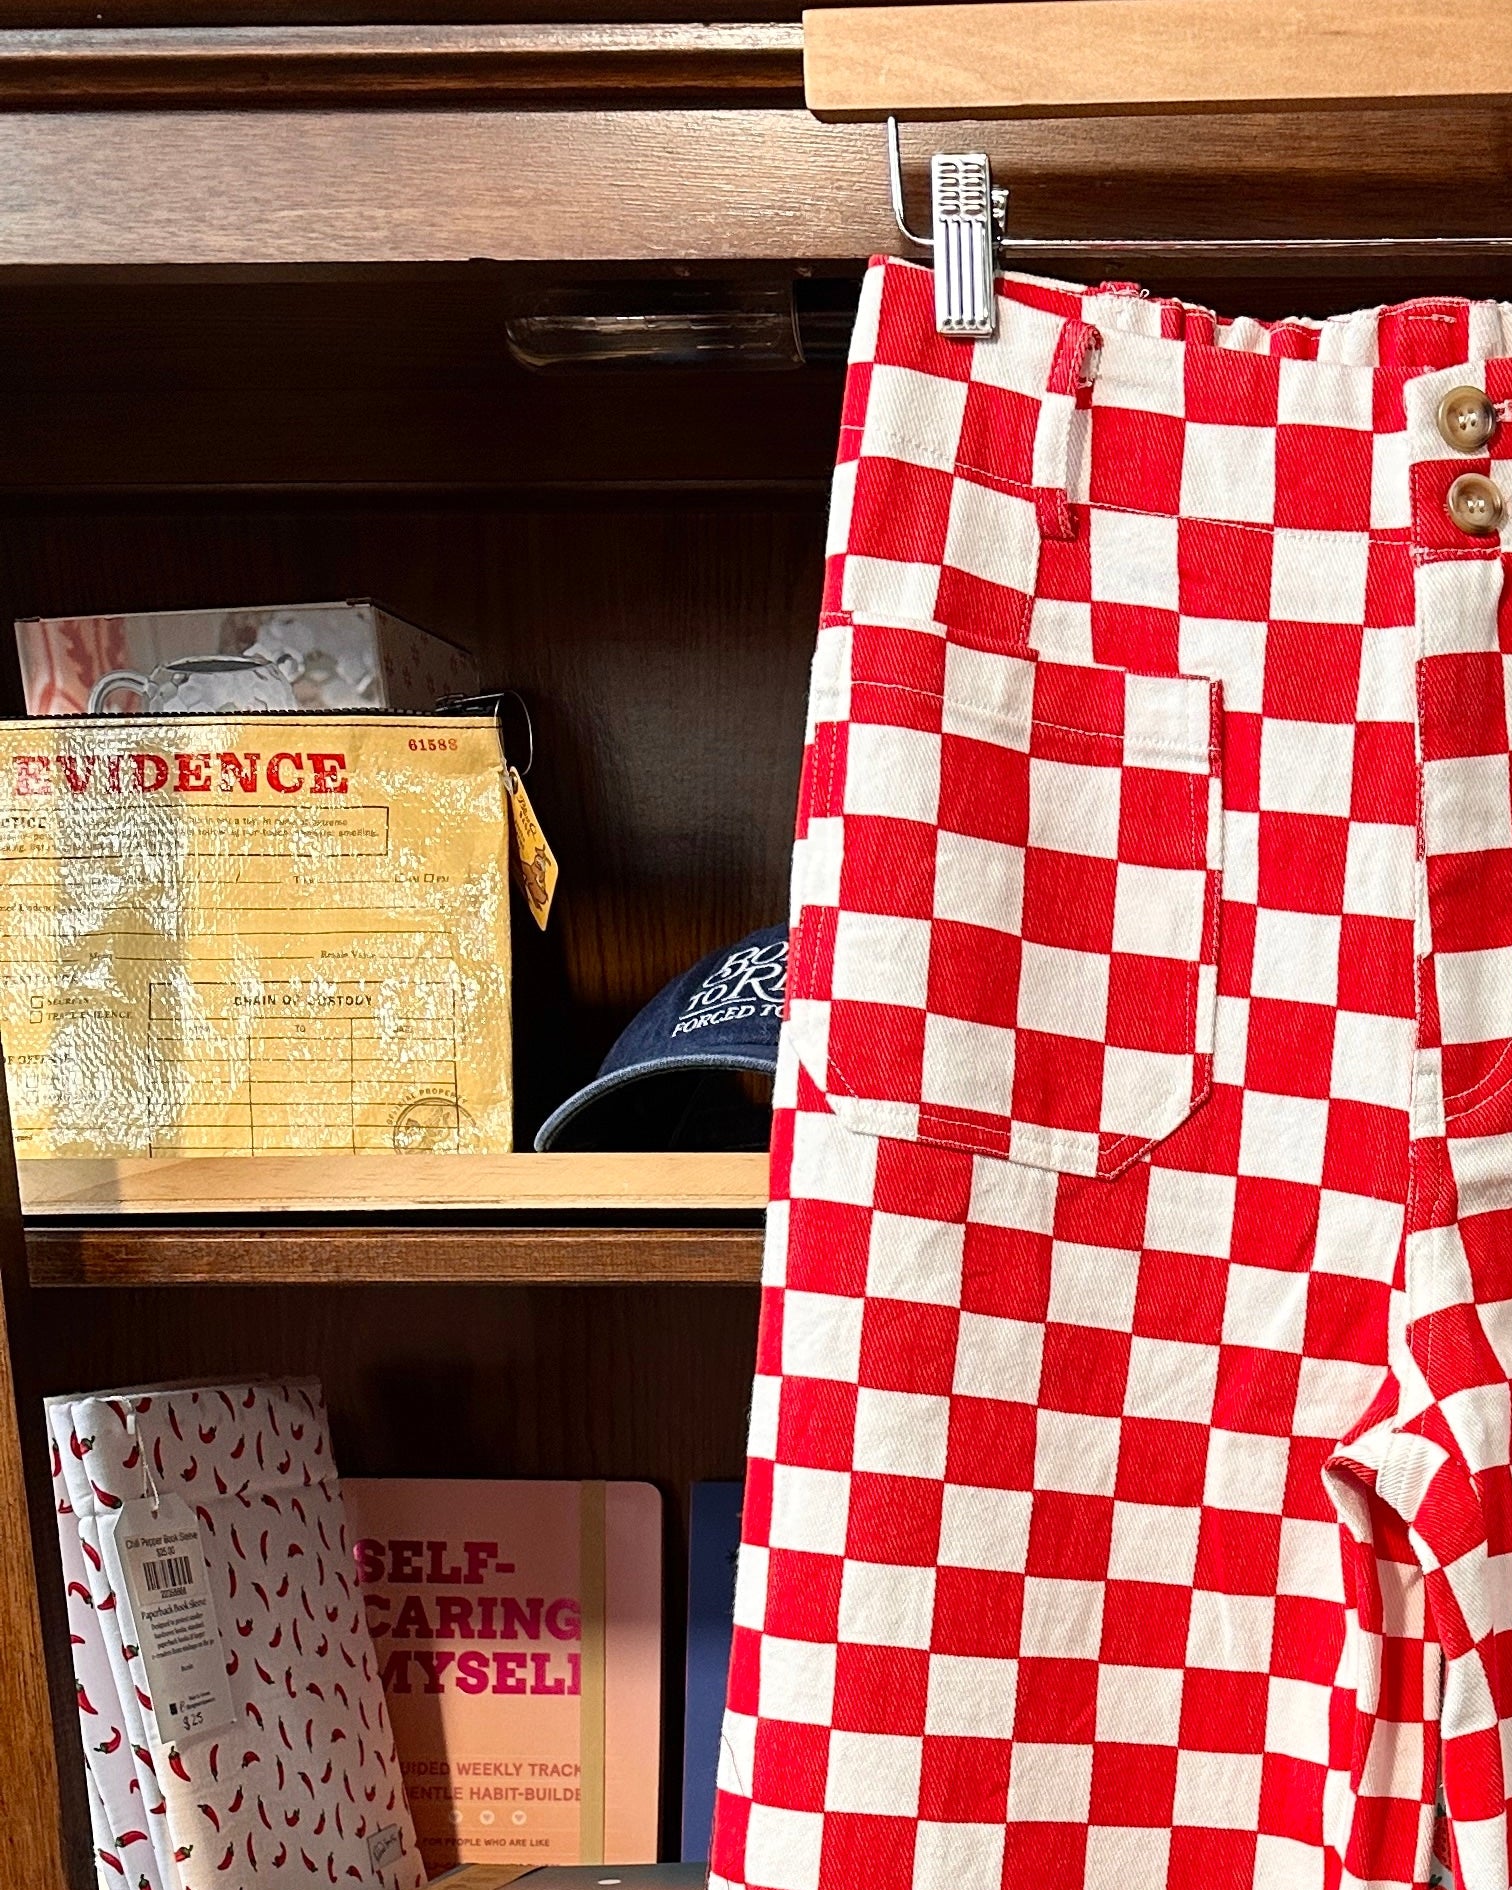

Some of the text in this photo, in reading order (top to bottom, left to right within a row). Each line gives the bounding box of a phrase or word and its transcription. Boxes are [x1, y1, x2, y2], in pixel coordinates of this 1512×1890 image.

[12, 752, 348, 796] EVIDENCE
[686, 984, 728, 1012] TO
[670, 1004, 756, 1038] FORCED
[353, 1538, 516, 1584] SELF-
[363, 1594, 582, 1641] CARING
[402, 1761, 450, 1776] UIDED
[456, 1762, 523, 1777] WEEKLY
[445, 1838, 481, 1847] PEOPLE
[484, 1839, 506, 1847] WHO
[509, 1839, 527, 1847] ARE
[530, 1839, 550, 1847] LIKE
